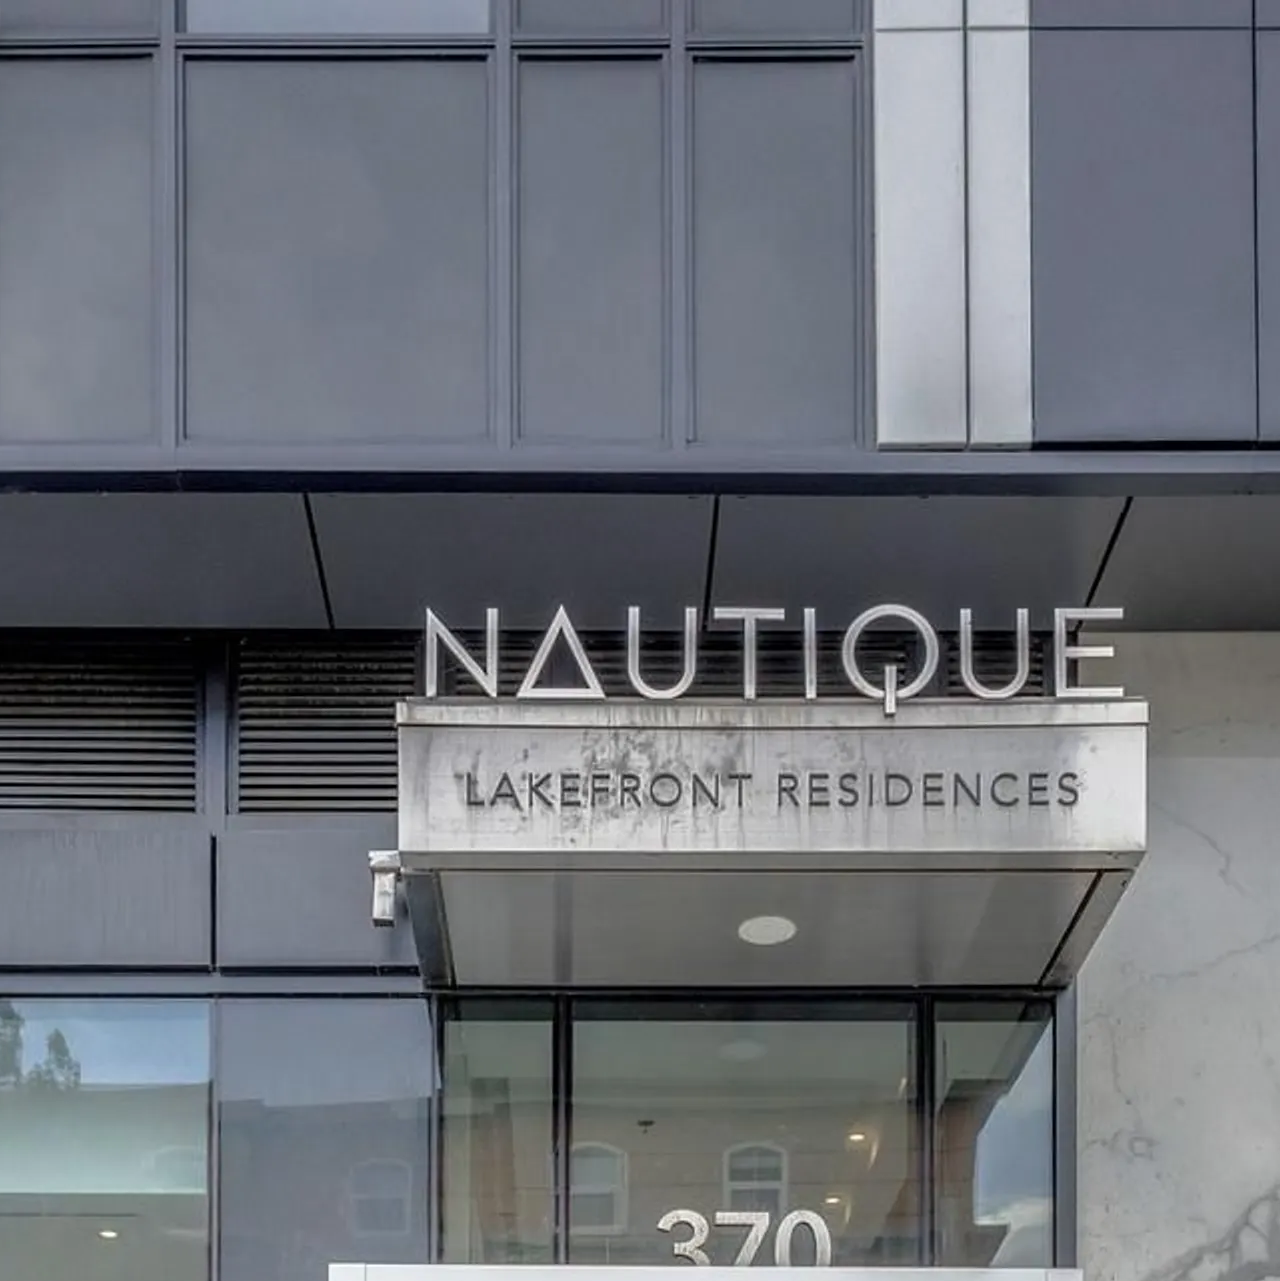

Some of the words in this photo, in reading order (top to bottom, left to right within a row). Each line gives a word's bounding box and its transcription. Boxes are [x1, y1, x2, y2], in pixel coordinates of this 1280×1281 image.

[426, 604, 1124, 716] NAUTIQUE
[465, 771, 752, 809] LAKEFRONT
[777, 771, 1082, 808] RESIDENCES
[656, 1209, 832, 1267] 370
